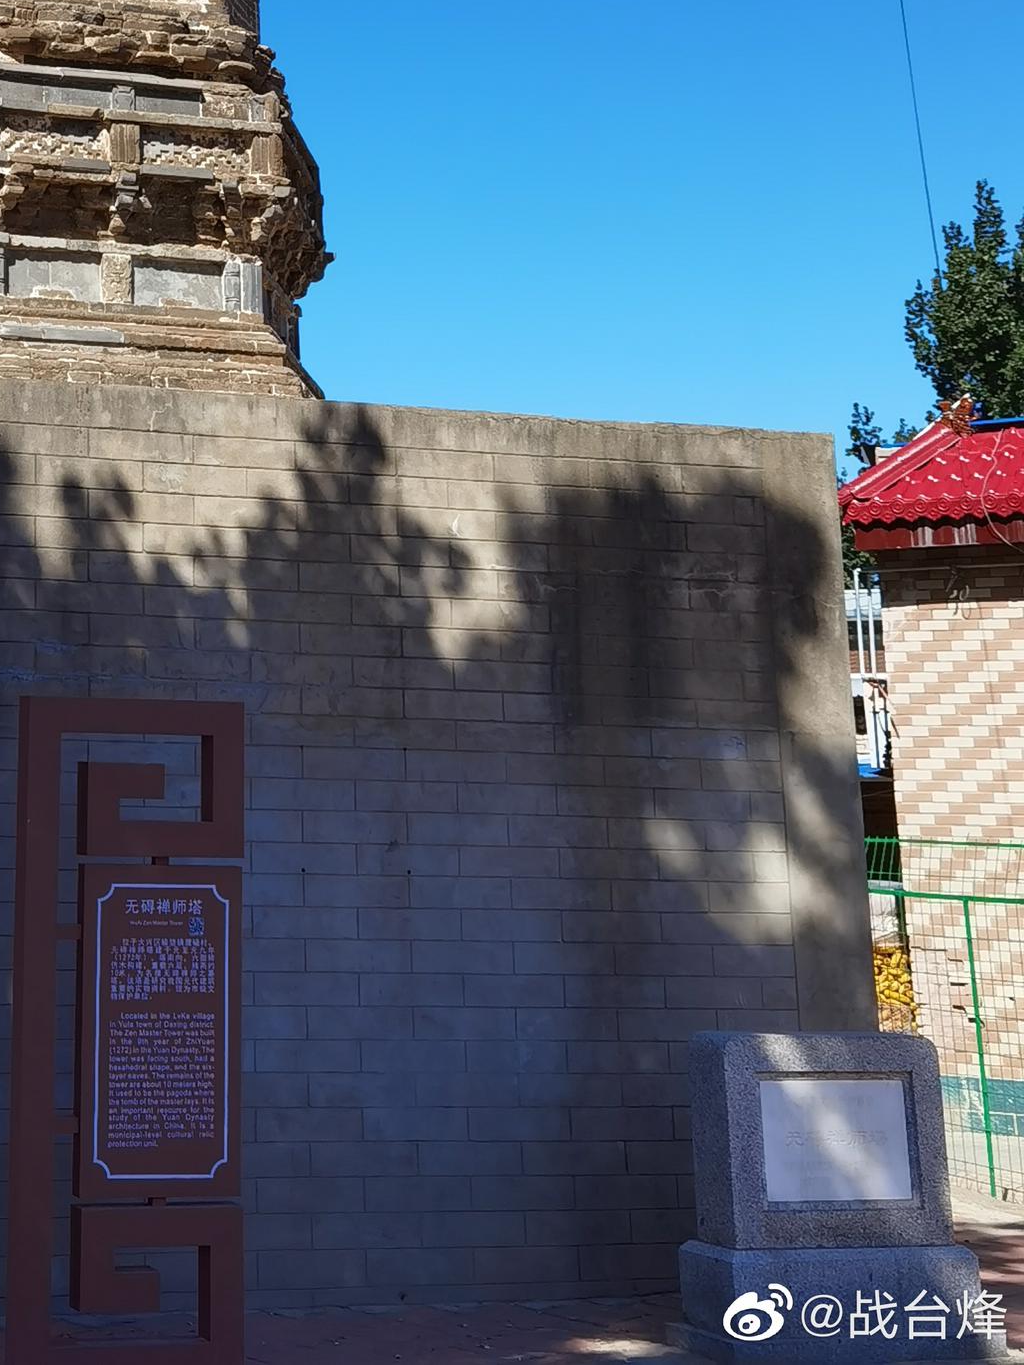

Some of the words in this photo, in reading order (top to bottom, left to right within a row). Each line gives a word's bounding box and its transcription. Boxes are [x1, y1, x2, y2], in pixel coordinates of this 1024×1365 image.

[125, 898, 203, 915] 无碍禅师塔
